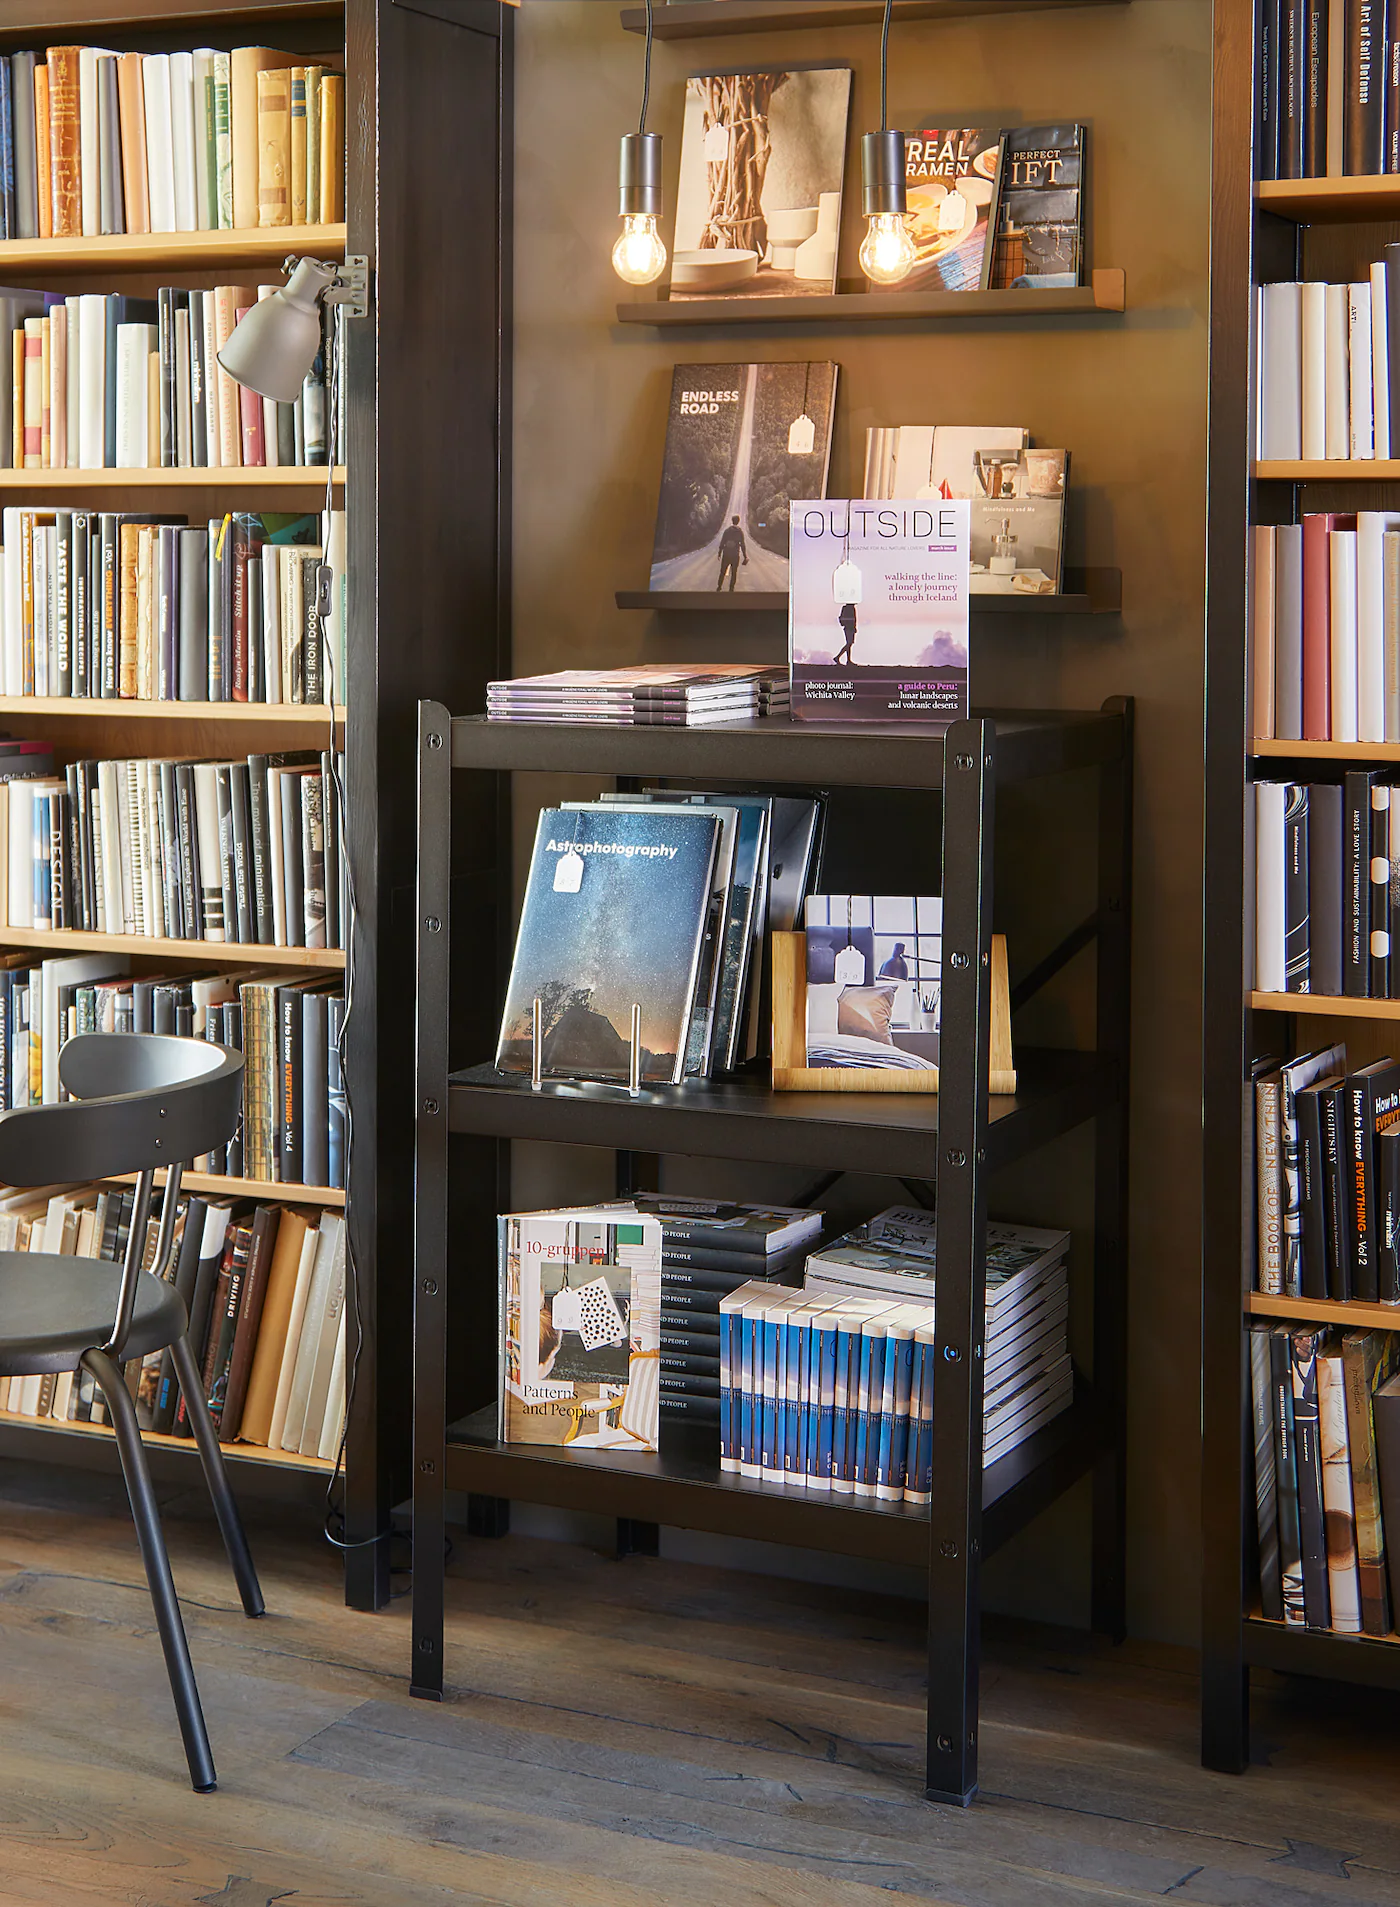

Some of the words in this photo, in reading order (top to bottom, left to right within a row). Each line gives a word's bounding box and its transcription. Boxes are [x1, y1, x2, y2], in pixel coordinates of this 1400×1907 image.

[1360, 6, 1372, 22] Art
[1310, 12, 1320, 55] European
[1360, 26, 1371, 38] of
[1360, 40, 1371, 60] Self
[1360, 64, 1370, 104] Defense
[908, 140, 970, 162] REAL
[1013, 150, 1060, 161] PERFECT
[906, 162, 969, 176] RAMEN
[681, 390, 739, 402] ENDLESS
[680, 403, 720, 414] ROAD
[803, 511, 956, 538] OUTSIDE
[58, 540, 68, 583] TASTE
[105, 550, 113, 562] Vol
[236, 564, 244, 577] up
[884, 573, 919, 582] walking
[234, 578, 242, 588] it
[896, 583, 922, 593] lonely
[924, 583, 958, 593] journey
[58, 587, 68, 615] THE
[105, 570, 113, 630] EVERYTHING
[889, 593, 924, 603] through
[308, 604, 316, 638] DOOR
[58, 619, 68, 672] WORLD
[105, 630, 113, 655] know
[105, 656, 113, 666] to
[308, 642, 316, 670] IRON
[105, 668, 113, 689] How
[235, 661, 243, 689] Roslyn
[308, 674, 316, 696] THE
[805, 682, 825, 690] photo
[833, 691, 855, 700] Valley
[904, 683, 926, 691] guide
[920, 692, 958, 701] landscapes
[252, 782, 260, 802] The
[253, 808, 261, 834] myth
[255, 839, 262, 850] of
[545, 839, 678, 860] Astrophotography
[50, 831, 62, 908] DESIGN
[184, 858, 192, 884] Explore
[256, 854, 265, 916] minimalism
[285, 1025, 292, 1035] to
[1354, 1090, 1363, 1114] How
[1376, 1097, 1390, 1114] How
[1391, 1093, 1398, 1107] to
[1354, 1116, 1362, 1128] to
[1266, 1132, 1277, 1168] NEW
[1355, 1130, 1364, 1159] know
[1266, 1187, 1278, 1207] OF
[1356, 1161, 1366, 1231] EVERYTHING
[1268, 1212, 1280, 1254] BOOK
[526, 1241, 605, 1258] 10-gruppen
[1358, 1241, 1367, 1256] Vol
[1358, 1258, 1367, 1266] 2
[1268, 1261, 1280, 1290] THE
[227, 1274, 240, 1318] DRIVING
[524, 1384, 578, 1400] Patterns
[522, 1403, 549, 1416] and
[551, 1404, 595, 1420] People
